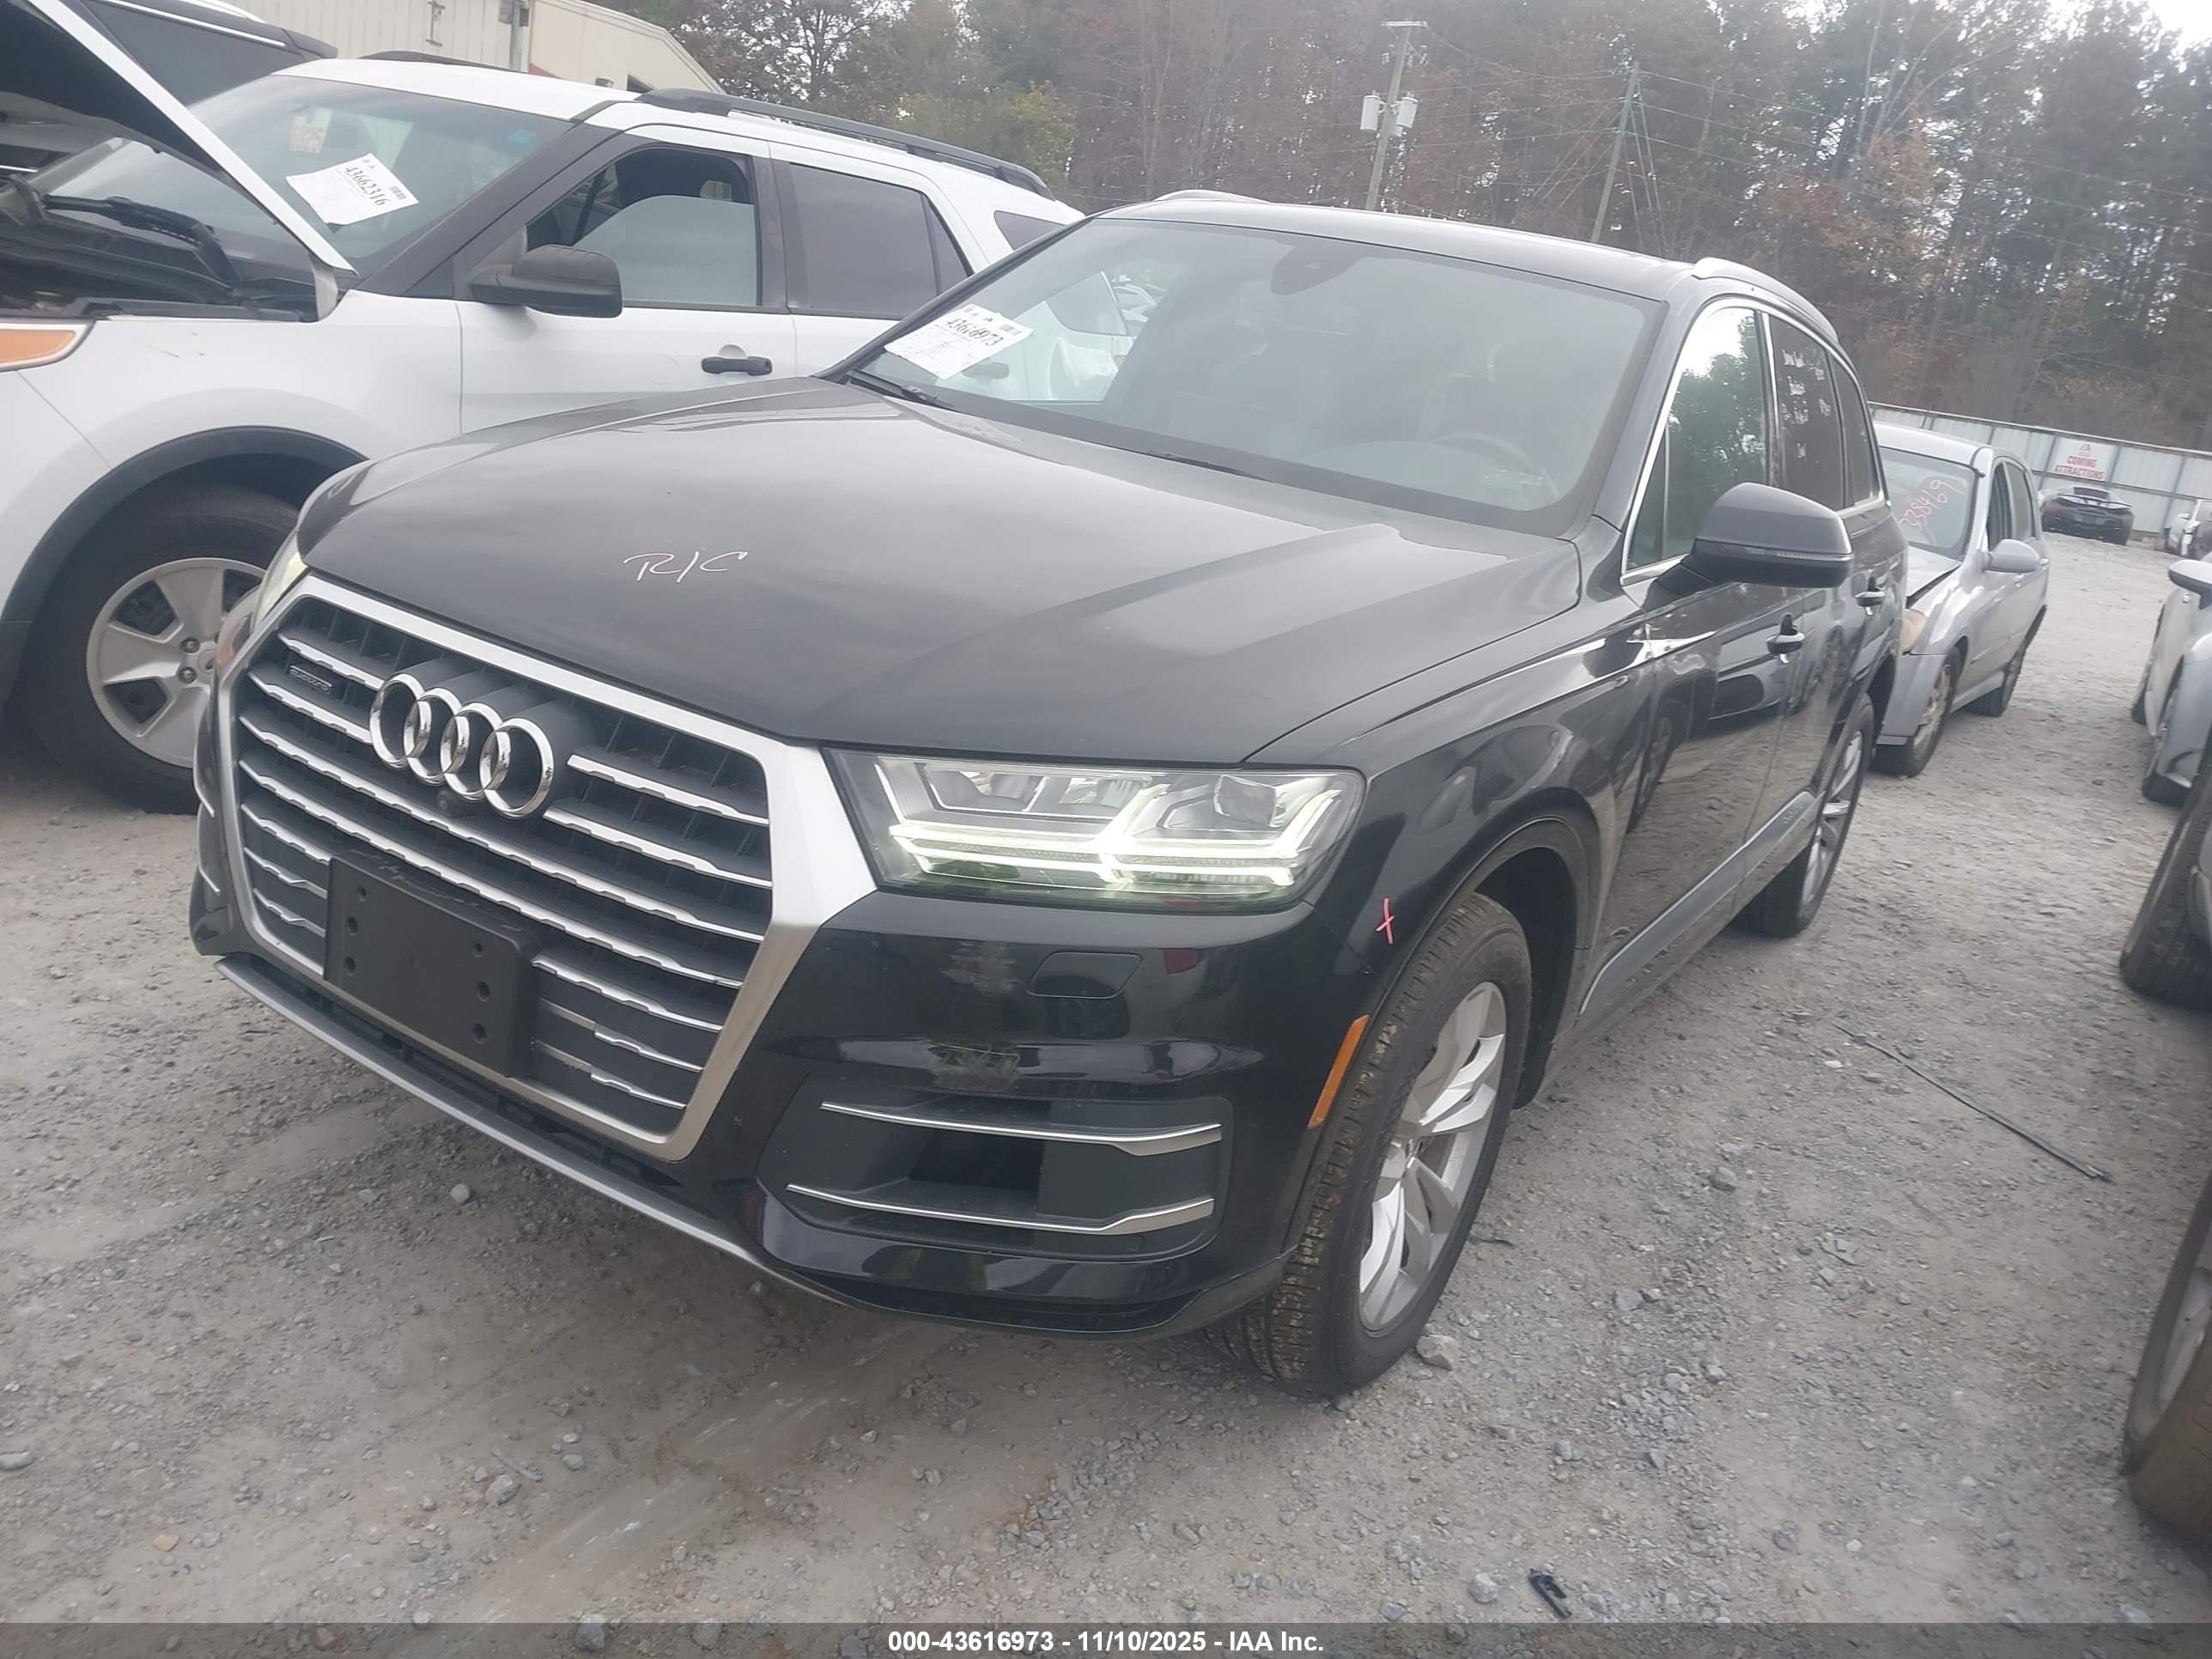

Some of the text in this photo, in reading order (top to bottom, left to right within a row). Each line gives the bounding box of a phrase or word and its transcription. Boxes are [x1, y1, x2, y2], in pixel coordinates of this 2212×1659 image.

[344, 166, 389, 206] 43662316
[946, 318, 1005, 346] 43616973
[2067, 455, 2098, 467] COMING
[2054, 465, 2105, 479] ATTRACTIONS
